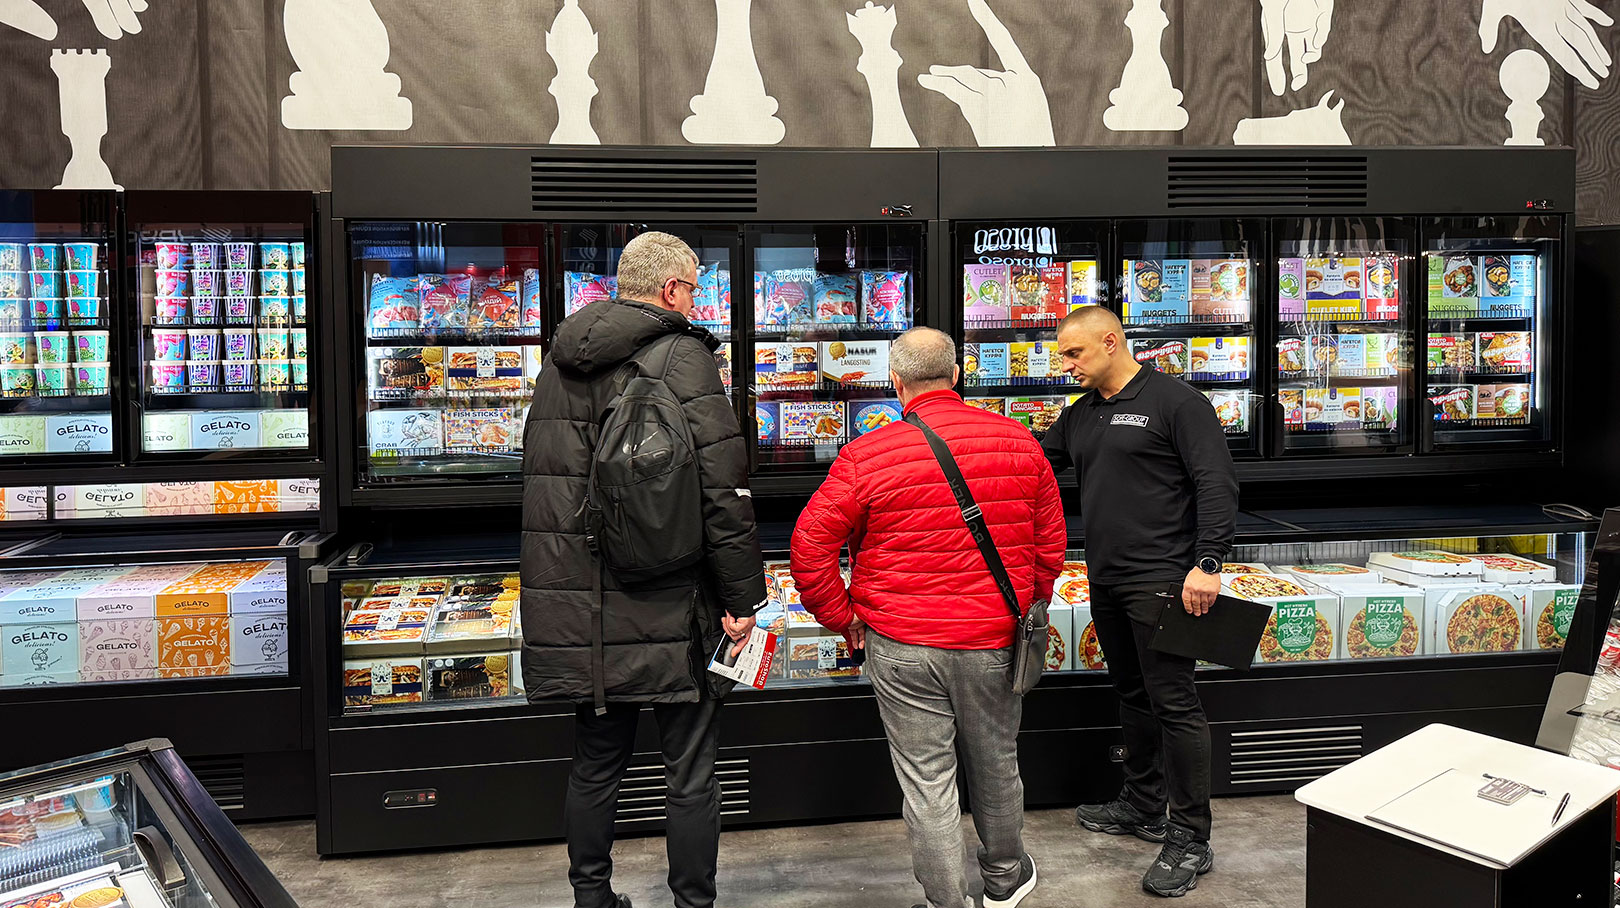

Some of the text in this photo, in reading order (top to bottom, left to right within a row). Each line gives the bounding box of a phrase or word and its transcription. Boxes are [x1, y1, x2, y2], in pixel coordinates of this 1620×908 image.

[1490, 303, 1522, 311] NUGGETS
[1142, 309, 1177, 317] NUGGETS
[56, 422, 109, 436] GELATO
[200, 421, 251, 433] GELATO
[174, 600, 210, 609] GELATO
[250, 597, 286, 607] GELATO
[1556, 595, 1579, 606] PIZZ
[18, 605, 55, 616] GELATO
[97, 603, 134, 613] GELATO
[1279, 606, 1315, 618] PIZZA
[1367, 602, 1403, 613] PIZZA
[243, 622, 287, 636] GELAT
[11, 631, 68, 645] GELATO
[174, 639, 214, 647] GELATO
[96, 642, 137, 650] GELATO
[758, 651, 773, 686] EuroShop
